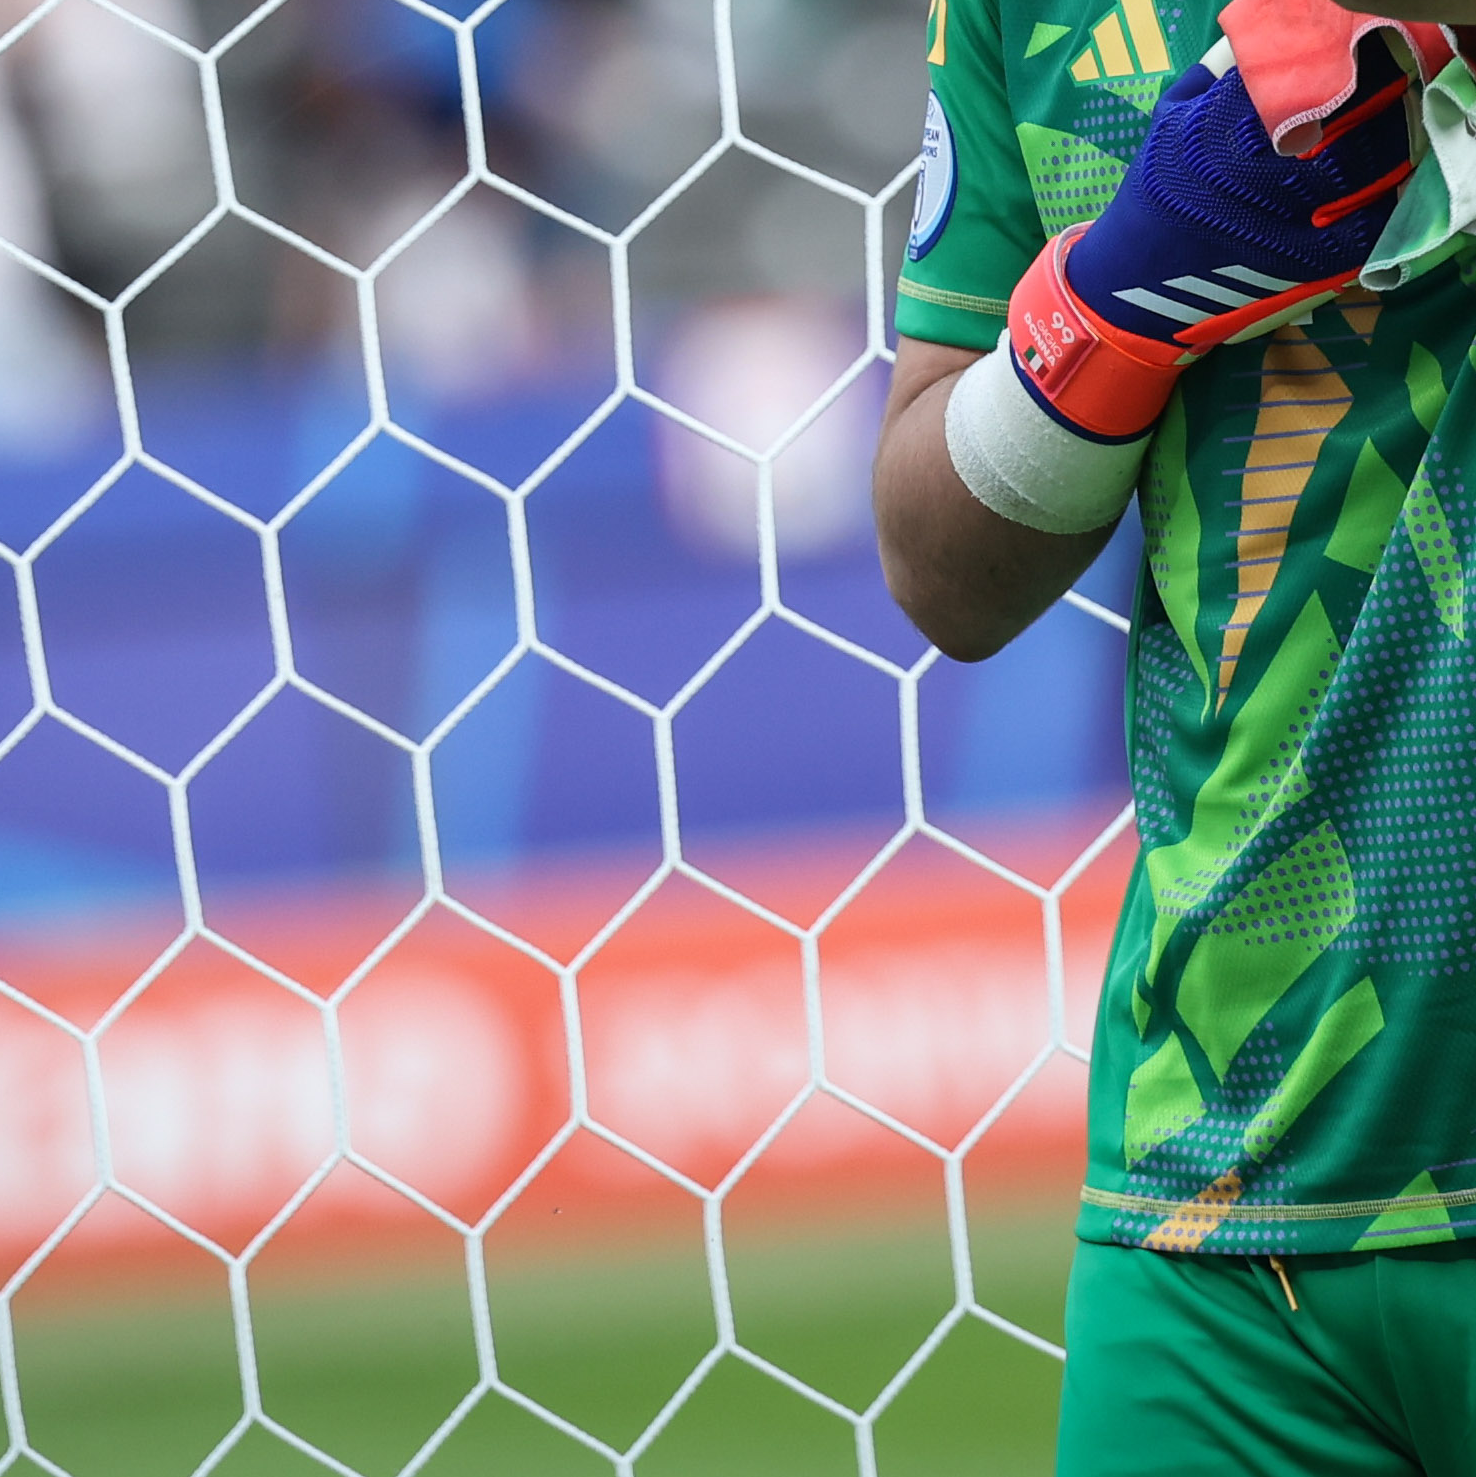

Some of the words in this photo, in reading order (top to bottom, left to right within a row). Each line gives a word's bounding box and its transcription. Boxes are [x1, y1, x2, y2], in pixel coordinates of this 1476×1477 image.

[1024, 311, 1056, 367] DONNA
[1036, 319, 1063, 358] GIGIO
[1050, 311, 1075, 344] 99
